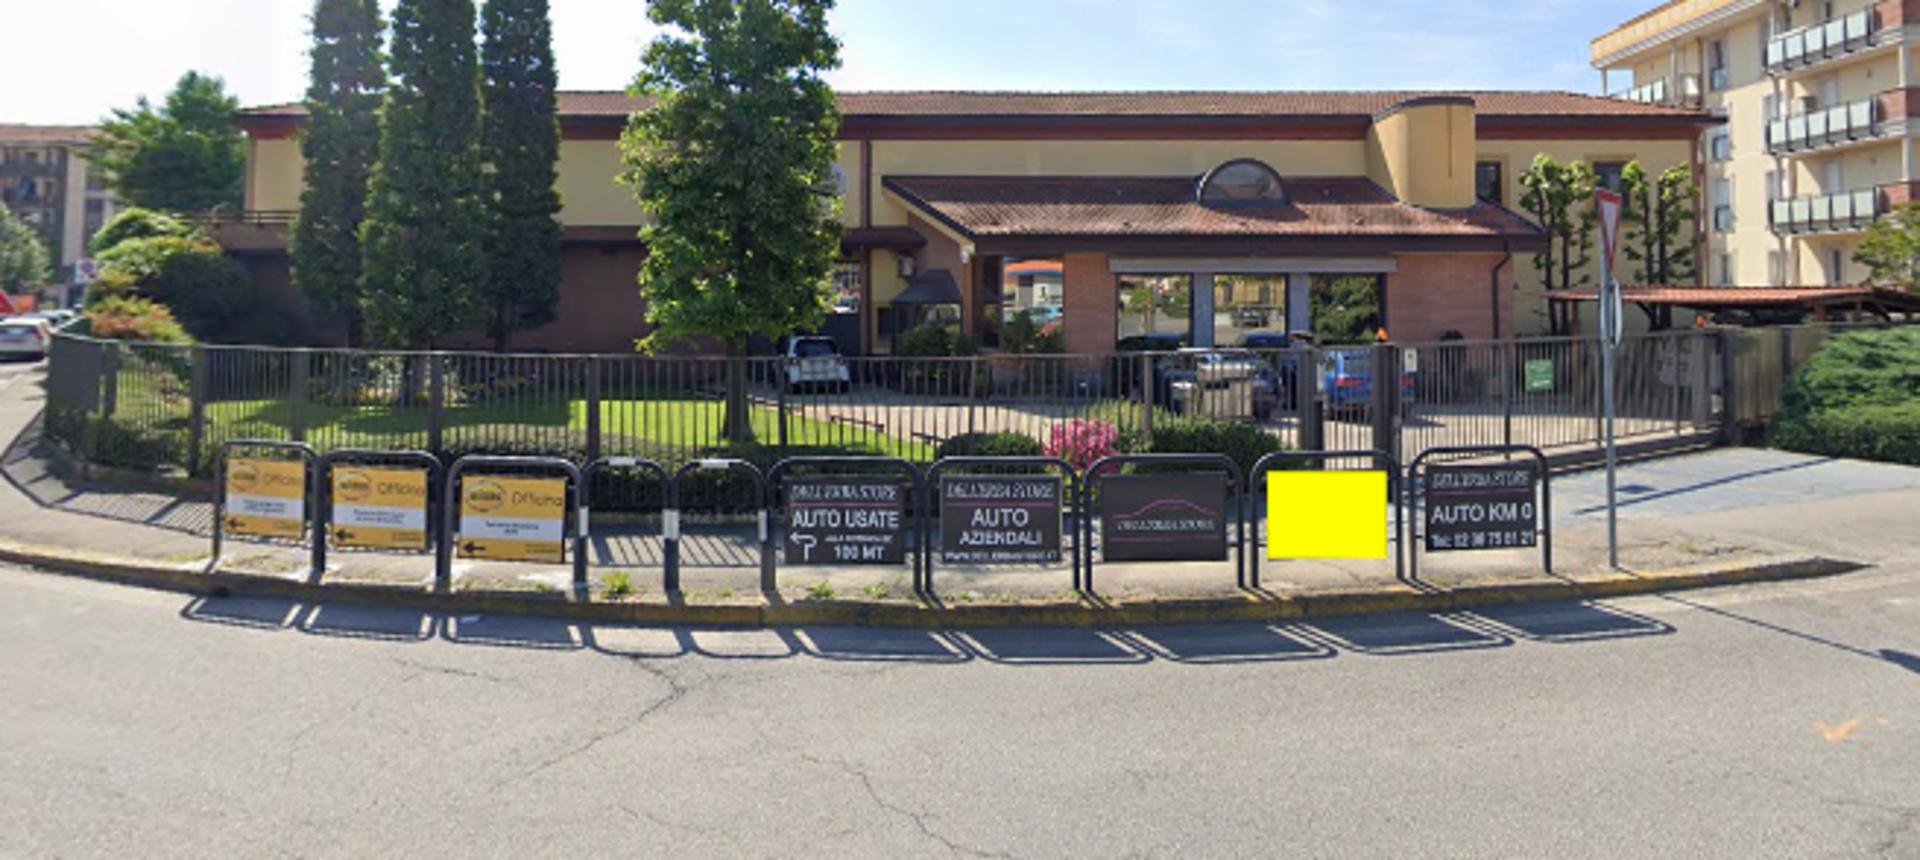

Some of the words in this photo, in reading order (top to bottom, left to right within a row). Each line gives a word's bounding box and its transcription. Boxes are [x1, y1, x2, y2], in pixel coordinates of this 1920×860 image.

[512, 490, 563, 507] Officina
[792, 508, 841, 528] AUTO
[845, 508, 900, 528] USATE
[971, 508, 1029, 528] AUTO
[1431, 504, 1485, 524] AUTO
[1489, 503, 1517, 521] KM
[960, 531, 1042, 545] AZIENDALI
[862, 544, 884, 559] MT
